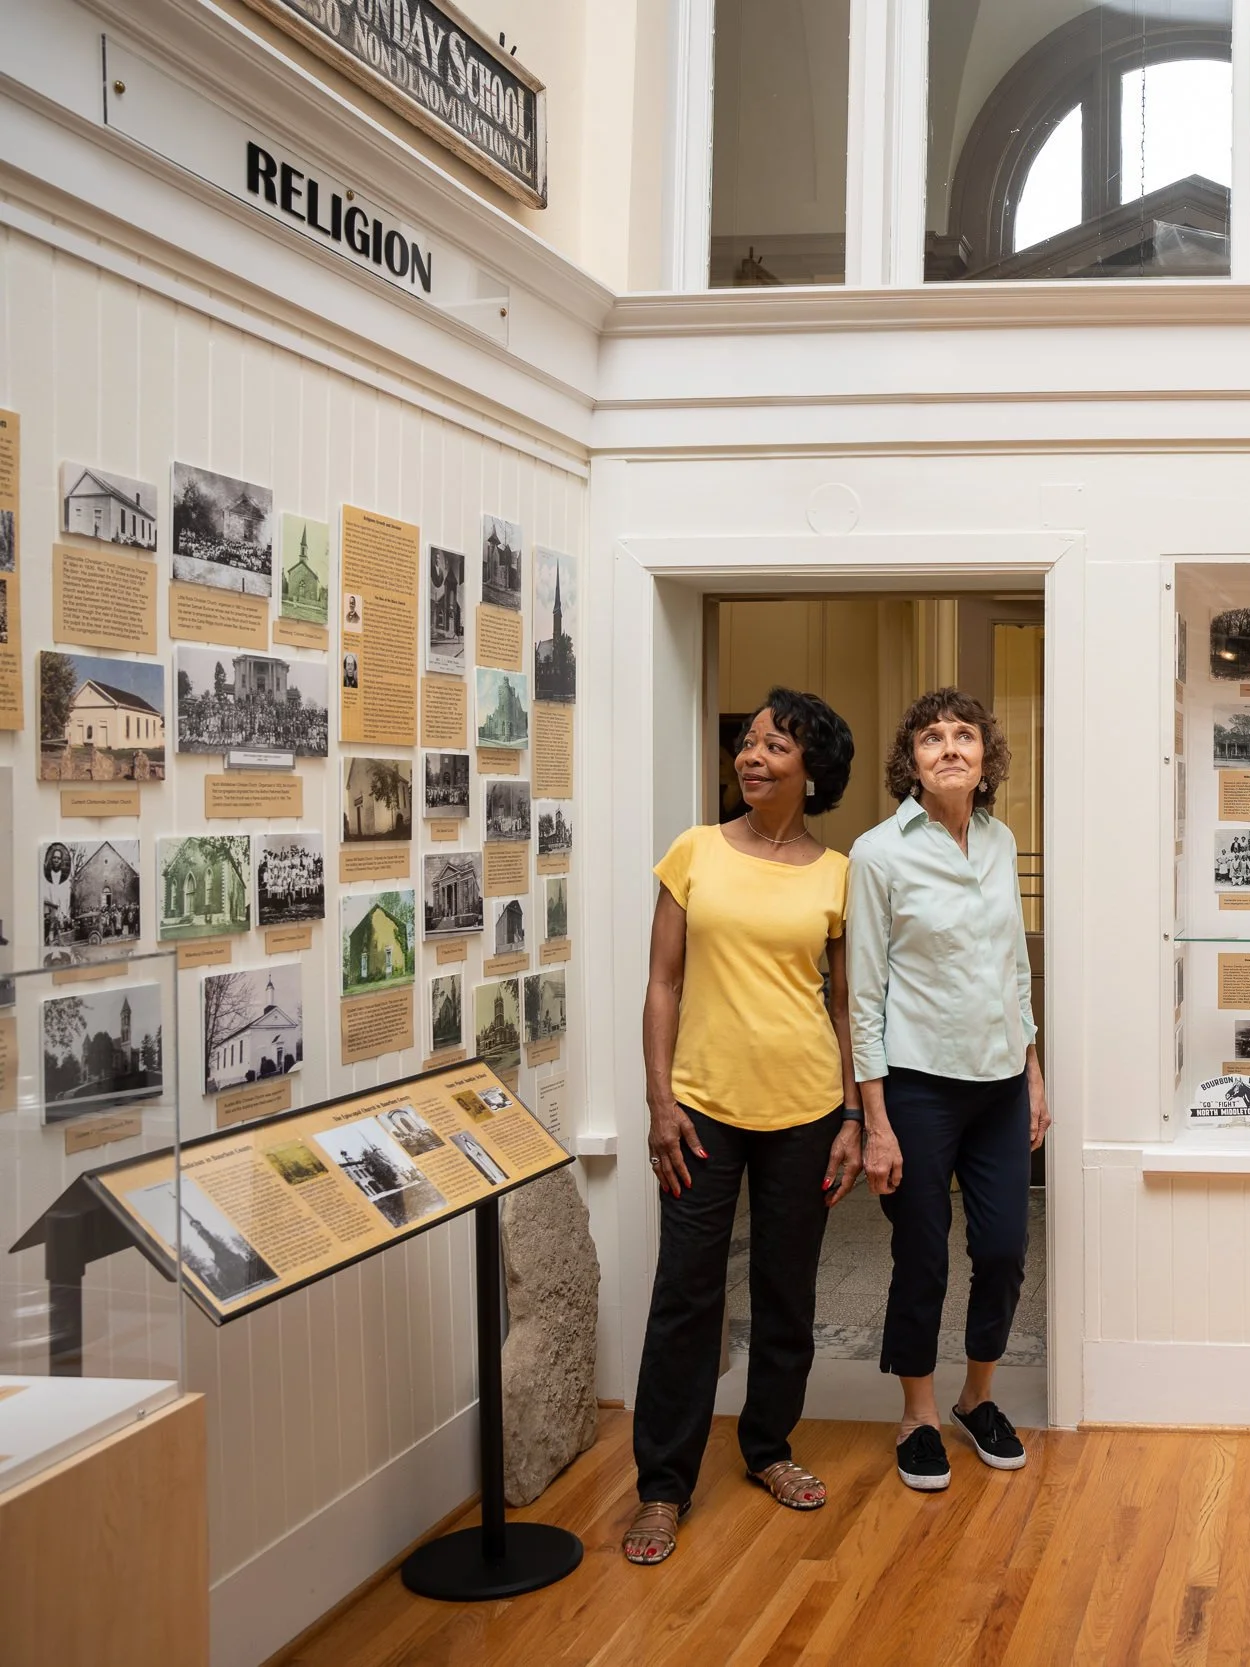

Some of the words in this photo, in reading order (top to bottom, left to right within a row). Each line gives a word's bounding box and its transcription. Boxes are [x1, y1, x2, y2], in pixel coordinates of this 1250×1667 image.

[344, 0, 445, 77] UNDAY
[448, 32, 532, 148] SCHOOL
[353, 12, 532, 178] NON-DENOMINATIONAL
[247, 141, 431, 293] RELIGION
[1201, 1076, 1234, 1091] BOURBON
